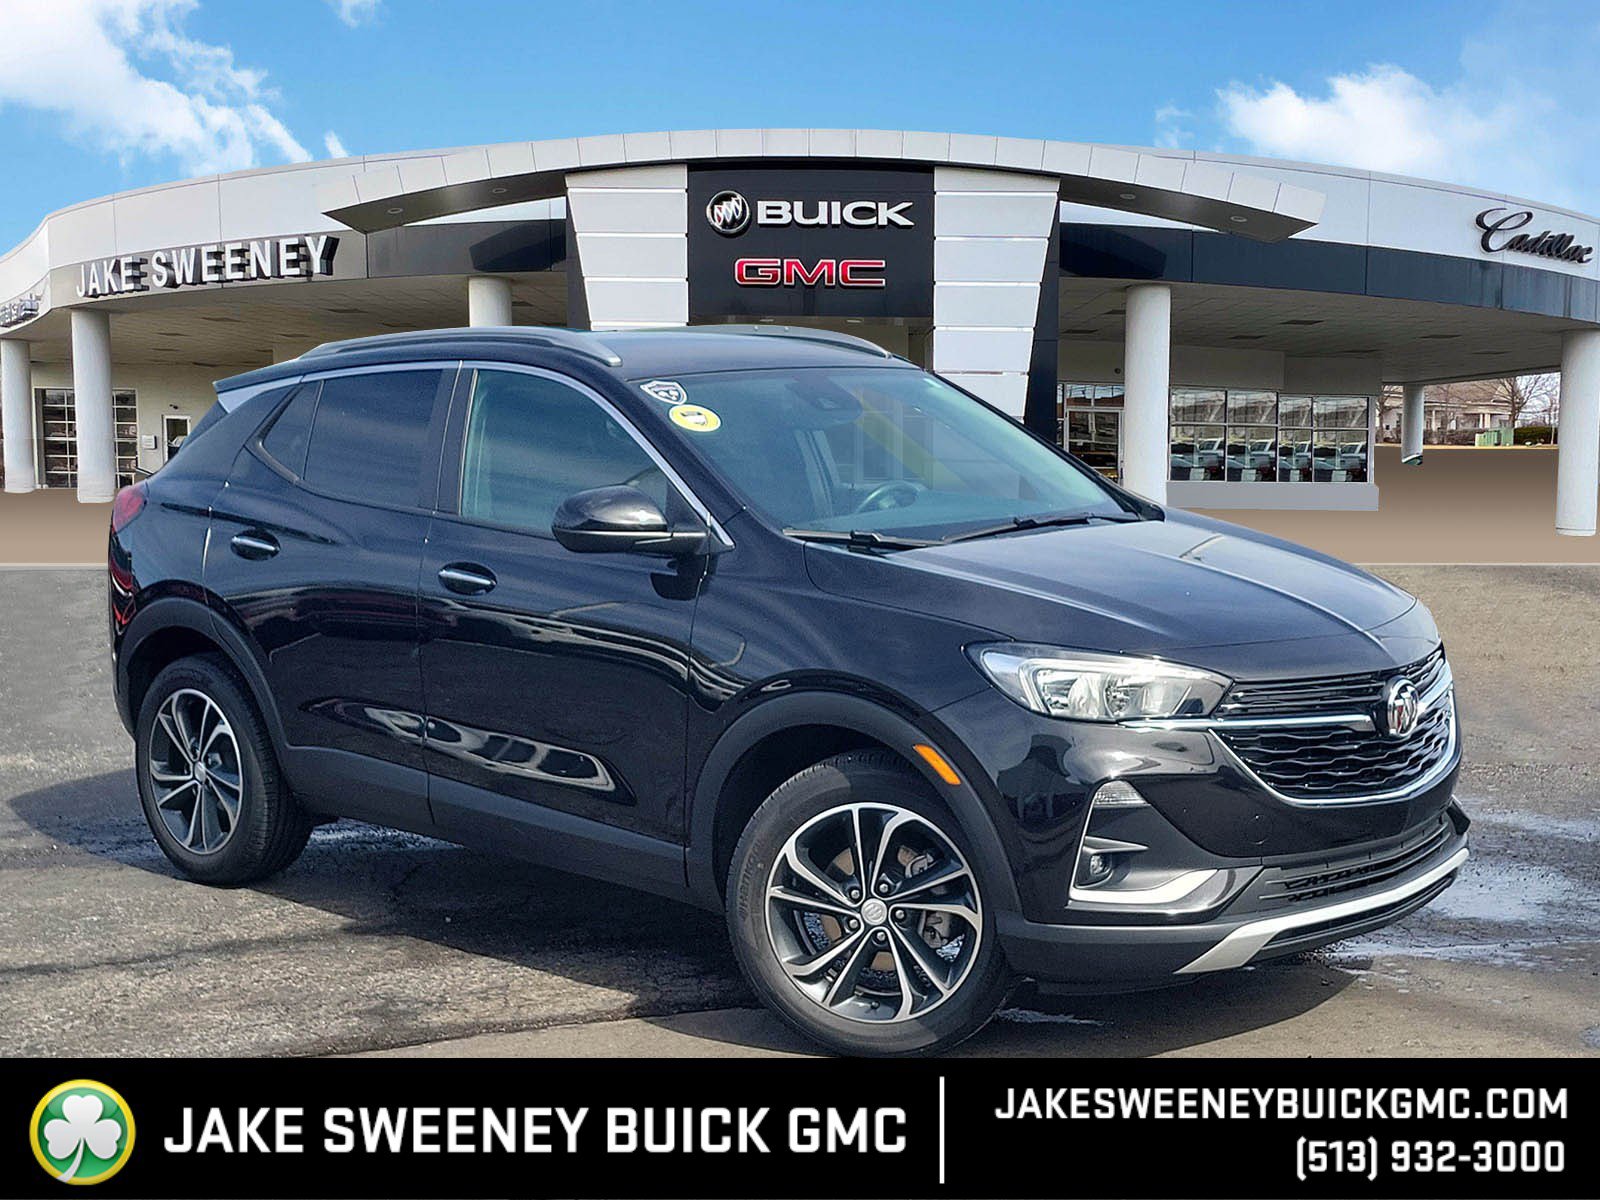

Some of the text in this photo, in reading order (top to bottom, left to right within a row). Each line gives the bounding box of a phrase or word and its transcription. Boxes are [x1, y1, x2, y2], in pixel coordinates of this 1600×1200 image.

[757, 200, 915, 227] BUICK
[1475, 207, 1594, 264] Cadillac
[76, 234, 336, 298] JAKE SWEENEY
[734, 258, 886, 288] GMC
